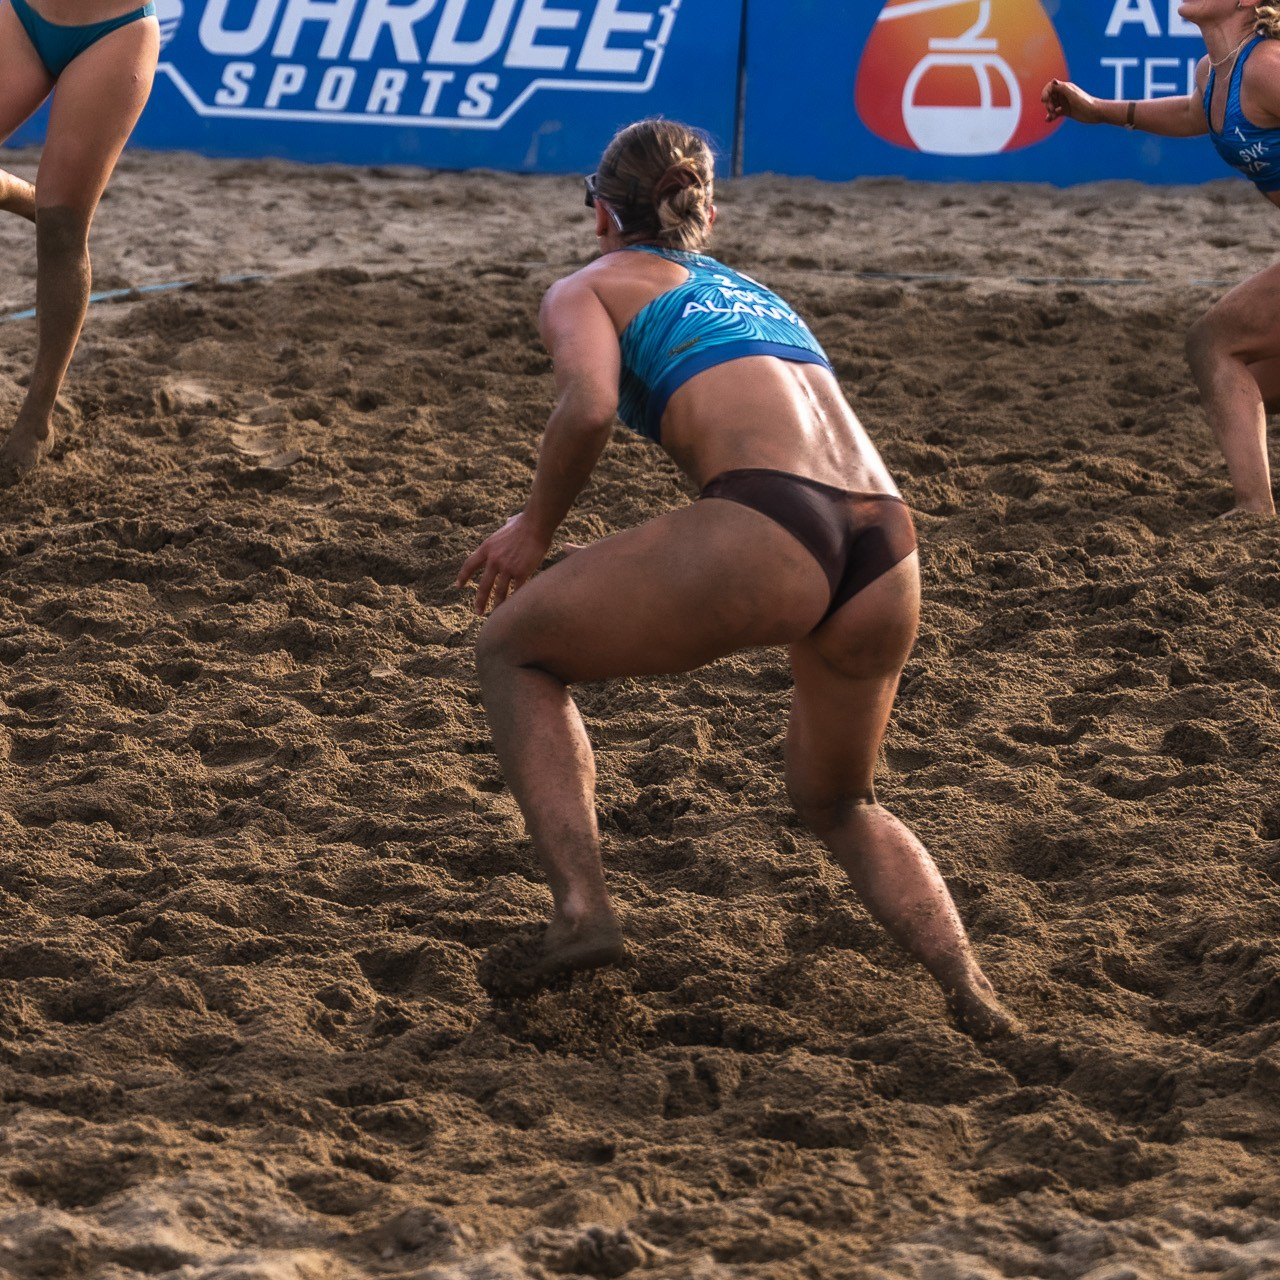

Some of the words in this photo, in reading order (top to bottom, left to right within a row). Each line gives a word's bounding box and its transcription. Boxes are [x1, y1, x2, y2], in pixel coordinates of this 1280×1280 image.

[214, 61, 500, 118] SPORTS
[1234, 125, 1246, 142] 1
[1239, 141, 1269, 162] SVK
